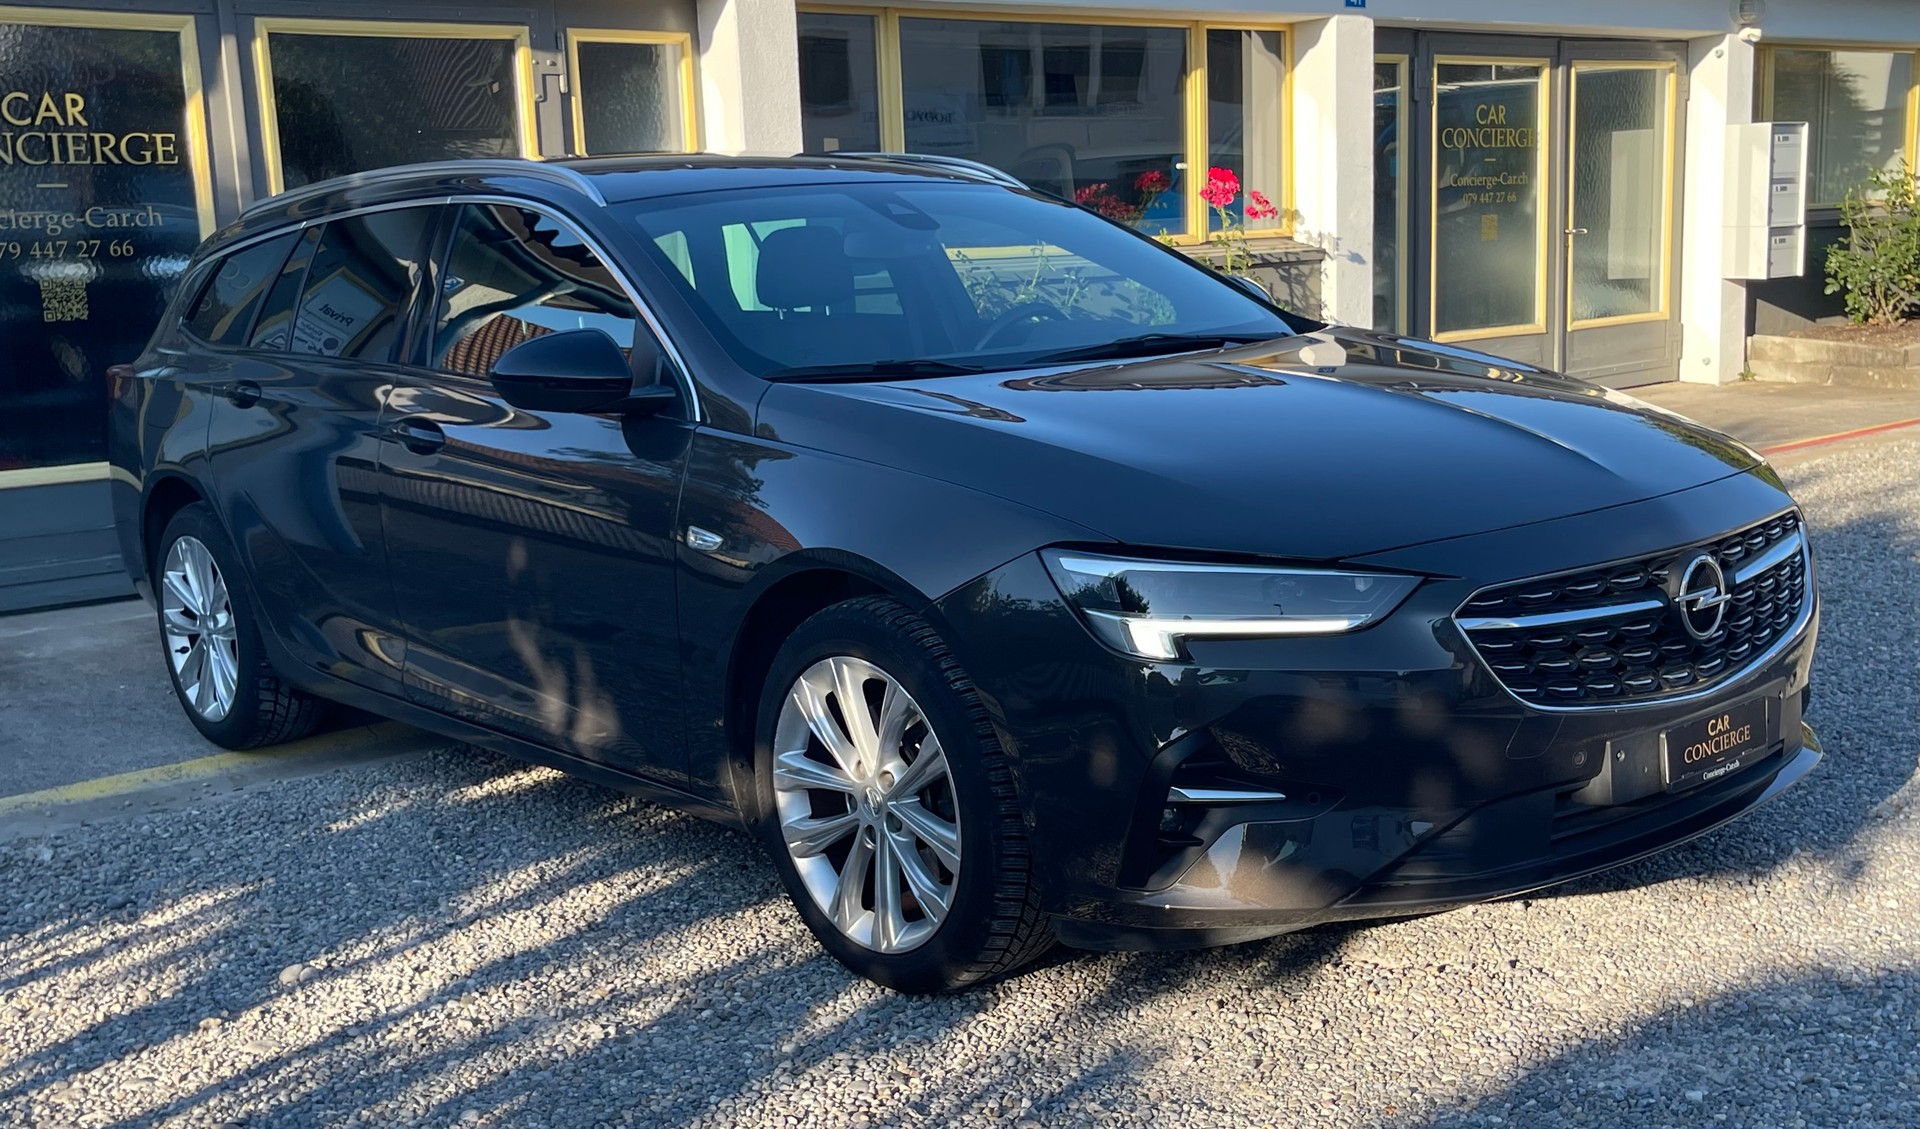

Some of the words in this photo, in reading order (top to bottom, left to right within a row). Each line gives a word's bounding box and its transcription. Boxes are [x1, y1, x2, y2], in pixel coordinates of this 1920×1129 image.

[2, 91, 89, 127] CAR
[1476, 104, 1506, 124] CAR
[1442, 128, 1537, 148] CONCIERGE
[1450, 172, 1529, 189] Concierge-Car.ch
[1463, 194, 1477, 204] 079
[1480, 192, 1494, 203] 447
[1496, 192, 1505, 202] 27
[1507, 192, 1517, 202] 66
[30, 241, 68, 259] 447
[78, 240, 101, 258] 27
[109, 239, 134, 257] 66
[1708, 715, 1730, 736] CAR
[1684, 725, 1751, 763] CONCIERGE
